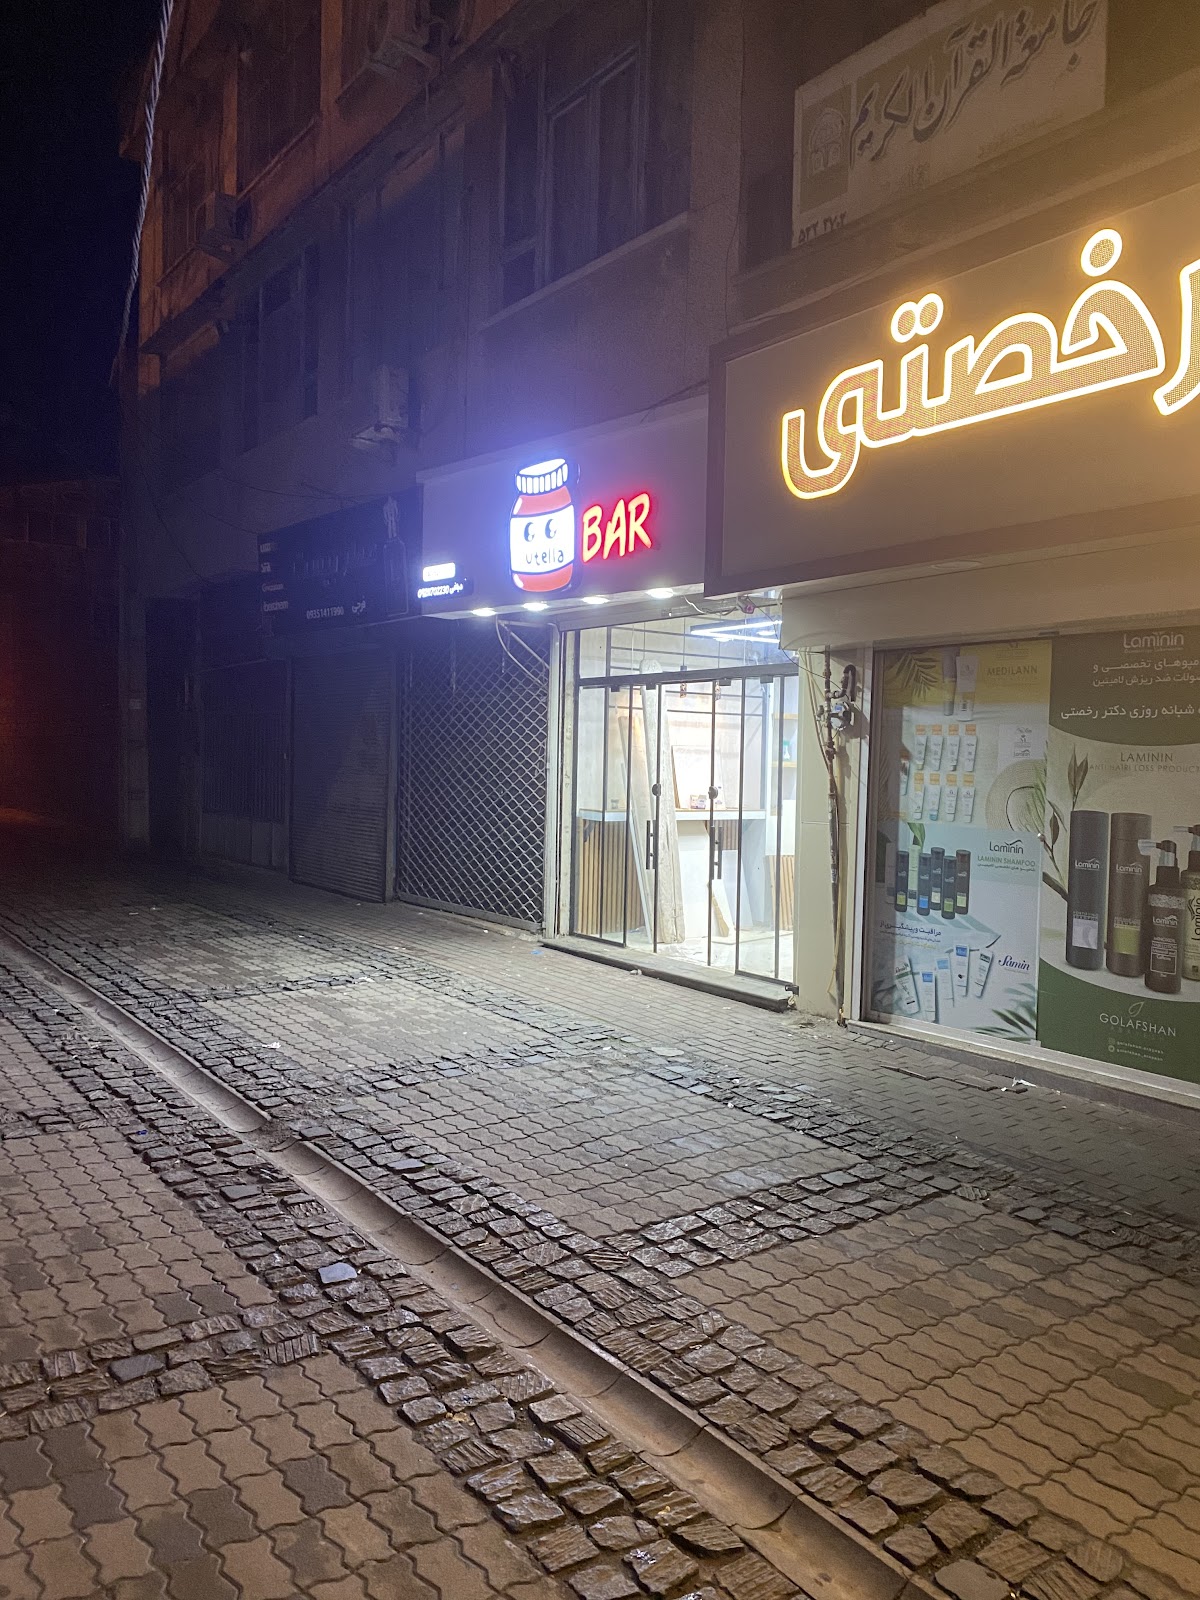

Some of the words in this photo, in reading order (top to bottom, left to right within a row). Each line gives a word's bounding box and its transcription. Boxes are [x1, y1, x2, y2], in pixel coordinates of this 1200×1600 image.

[580, 491, 653, 564] BAR
[1122, 631, 1185, 649] Laminin
[1101, 659, 1152, 673] تخصصی
[1154, 657, 1200, 671] مپوهای
[1060, 704, 1099, 720] رخصتی
[1101, 704, 1127, 719] دکتر
[1129, 704, 1159, 719] روزی
[1160, 703, 1195, 718] شبانه
[1120, 751, 1174, 763] LAMININ
[989, 839, 1024, 855] Laminin
[1099, 1012, 1177, 1038] GOLAFSHAN
